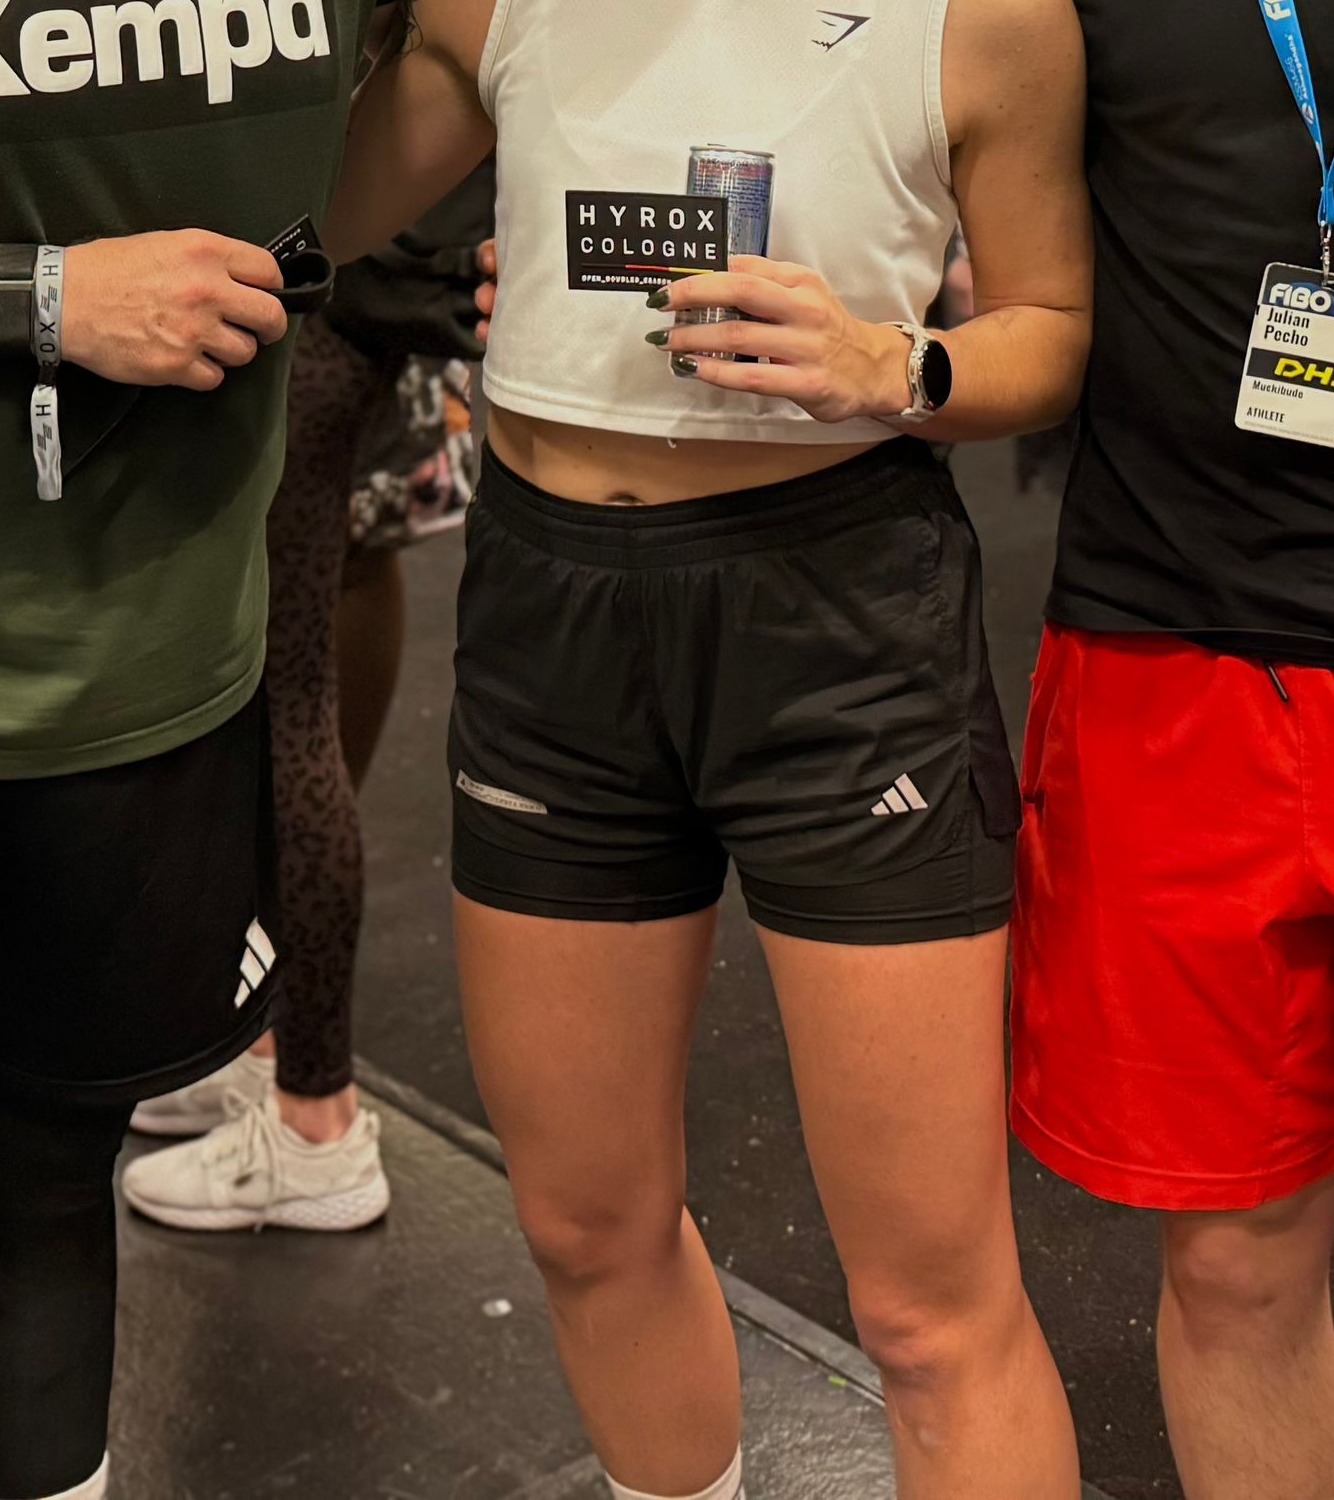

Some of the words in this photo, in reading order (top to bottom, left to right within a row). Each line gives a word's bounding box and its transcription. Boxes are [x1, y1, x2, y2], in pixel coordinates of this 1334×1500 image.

[579, 204, 715, 231] HYROX
[580, 237, 716, 260] COLOGNE
[1269, 283, 1332, 313] FIBO
[1267, 308, 1310, 329] Julian
[1246, 406, 1286, 423] ATHLETE
